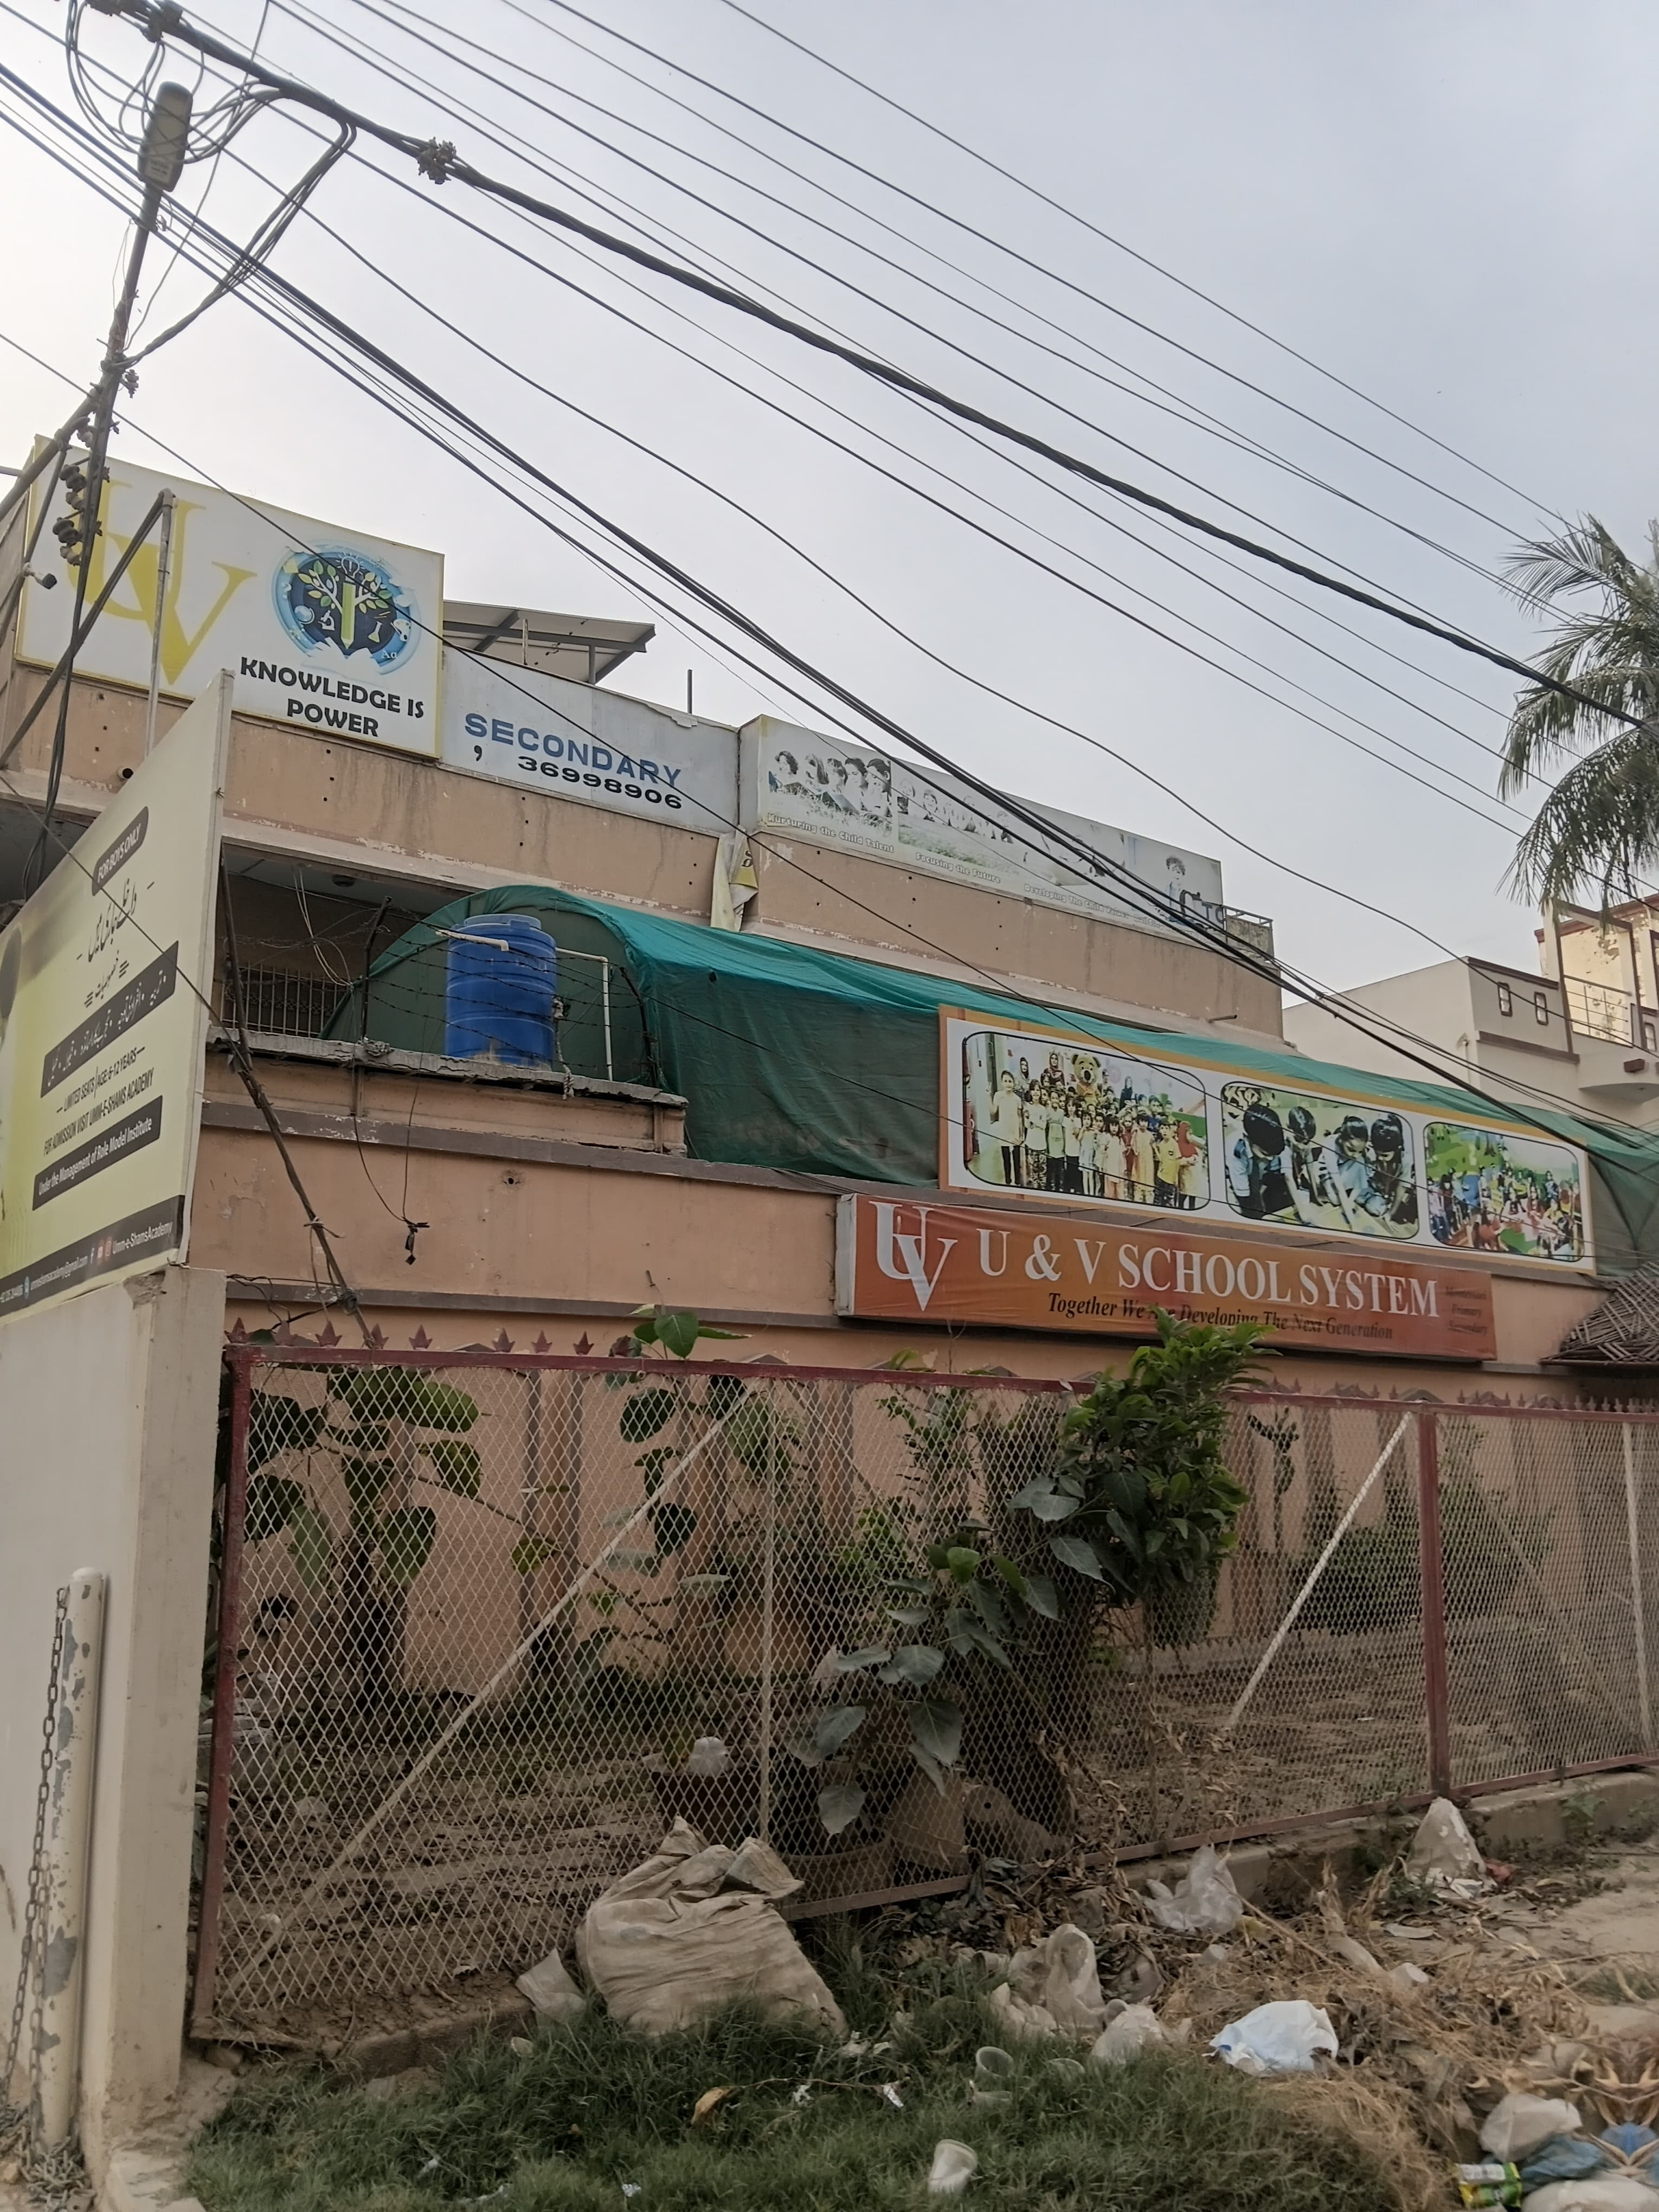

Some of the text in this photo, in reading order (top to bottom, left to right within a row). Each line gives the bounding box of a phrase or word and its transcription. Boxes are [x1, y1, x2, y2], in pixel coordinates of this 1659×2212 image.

[241, 657, 423, 718] KNOWLEDGE IS
[287, 699, 378, 737] POWER
[465, 713, 681, 787] SECONDARY
[518, 756, 682, 809] 36998906
[98, 822, 141, 883] FOR BOYS ONLY
[767, 813, 894, 853] Nurturing the Child Talent
[916, 852, 1001, 884] Focusing the Future
[1024, 884, 1067, 903] Developing
[1069, 896, 1083, 906] The
[81, 1076, 95, 1100] SEATS
[120, 1047, 137, 1072] YEARS
[126, 1067, 154, 1102] ACADEMY
[51, 1172, 59, 1187] the
[59, 1153, 91, 1182] Management
[91, 1146, 97, 1164] of
[97, 1141, 108, 1160] Role
[110, 1128, 127, 1154] Model
[127, 1117, 152, 1142] Institute
[976, 1228, 1011, 1276] U
[1025, 1234, 1062, 1281] &
[1073, 1238, 1108, 1284] V
[1118, 1243, 1291, 1302] SCHOOL
[1301, 1264, 1440, 1317] SYSTEM
[1049, 1293, 1117, 1319] Together
[1122, 1298, 1143, 1318] We
[1264, 1311, 1287, 1330] The
[1326, 1317, 1393, 1339] Generation
